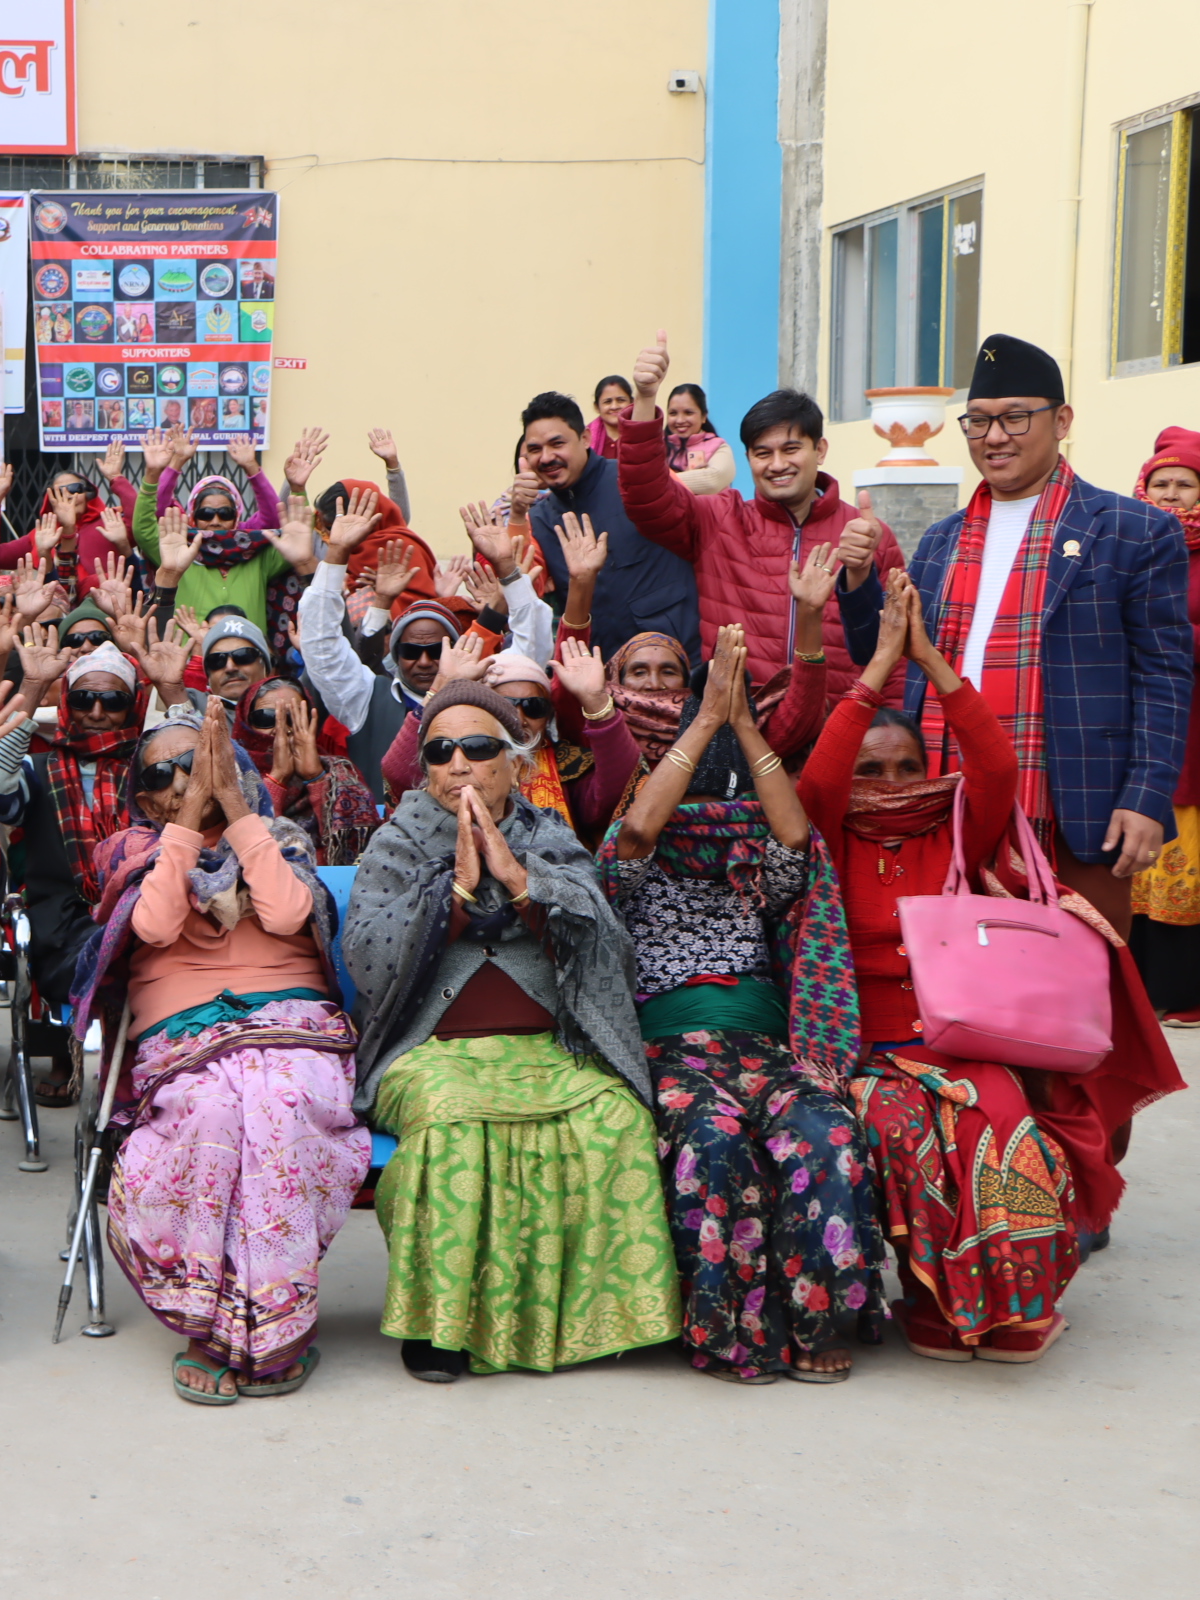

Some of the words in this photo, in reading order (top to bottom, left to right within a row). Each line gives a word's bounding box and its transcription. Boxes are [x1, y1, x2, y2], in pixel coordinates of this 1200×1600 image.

[71, 202, 103, 216] Thank
[105, 207, 122, 219] you
[125, 203, 140, 219] for
[143, 207, 164, 219] your
[87, 220, 121, 234] Support
[122, 221, 139, 231] and
[141, 220, 179, 234] Generous
[181, 220, 224, 231] Donations
[80, 245, 168, 255] COLLABRATING
[171, 245, 228, 255] PARTNERS
[122, 348, 191, 358] SUPPORTERS
[275, 358, 306, 368] EXIT
